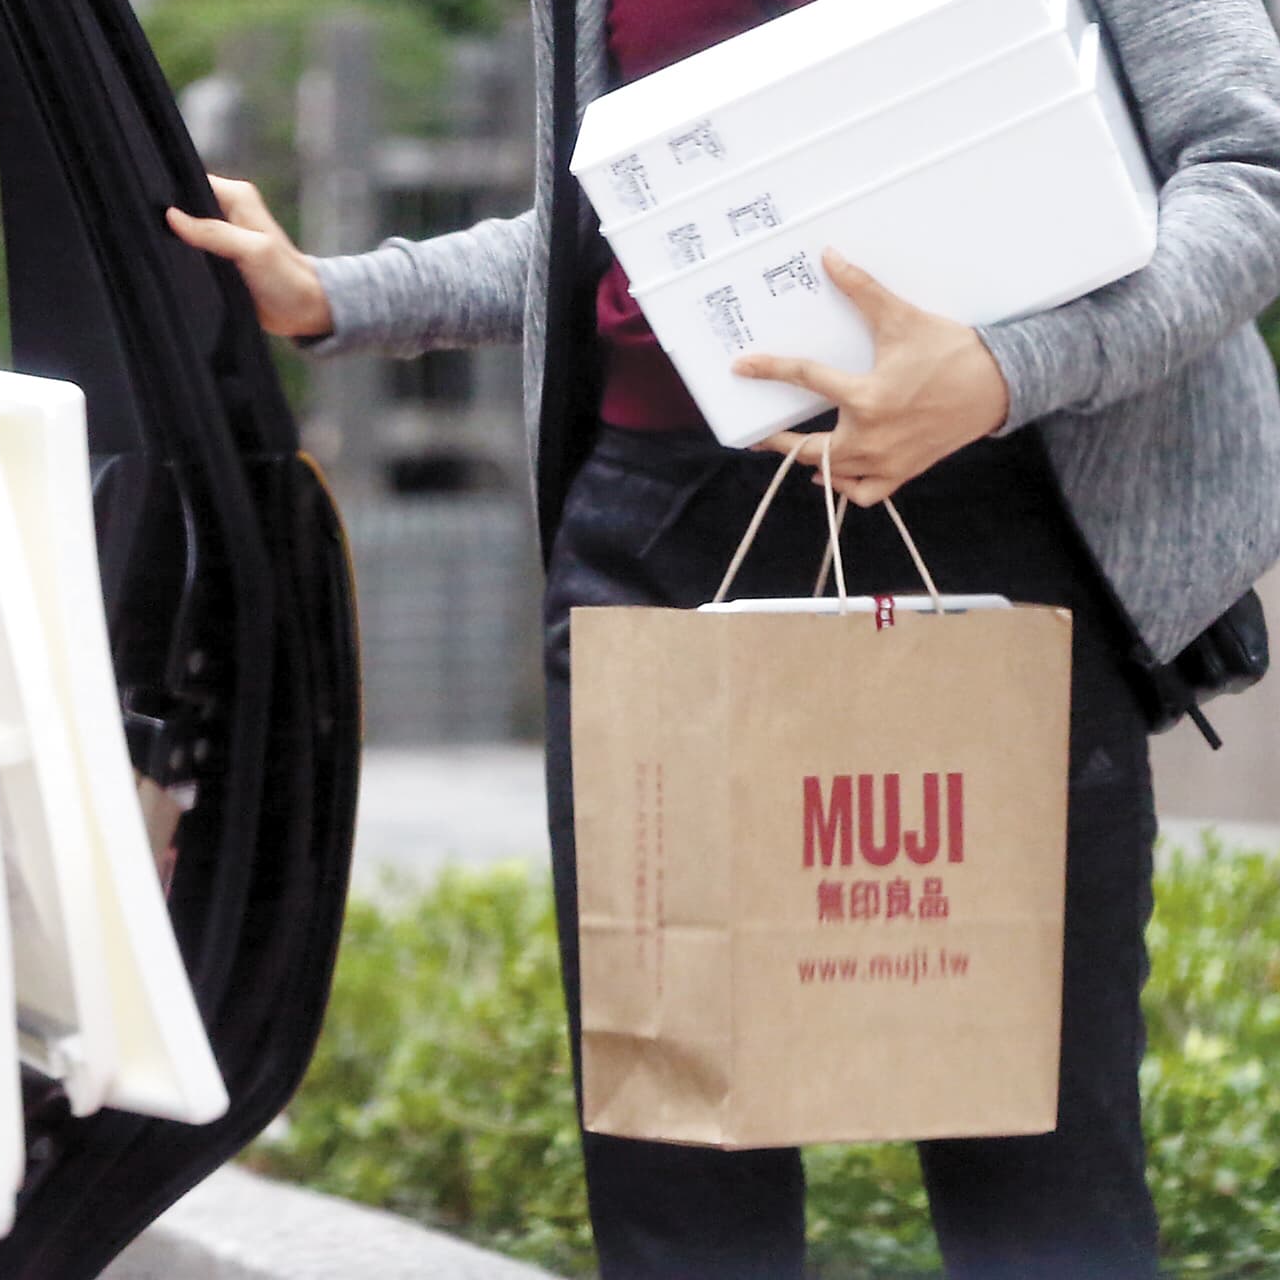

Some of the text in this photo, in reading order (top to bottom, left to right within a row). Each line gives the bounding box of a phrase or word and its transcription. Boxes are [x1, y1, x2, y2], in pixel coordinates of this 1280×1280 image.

[803, 772, 964, 868] MUJI
[817, 876, 950, 922] 無印良品
[798, 948, 969, 986] www.muji.tw
